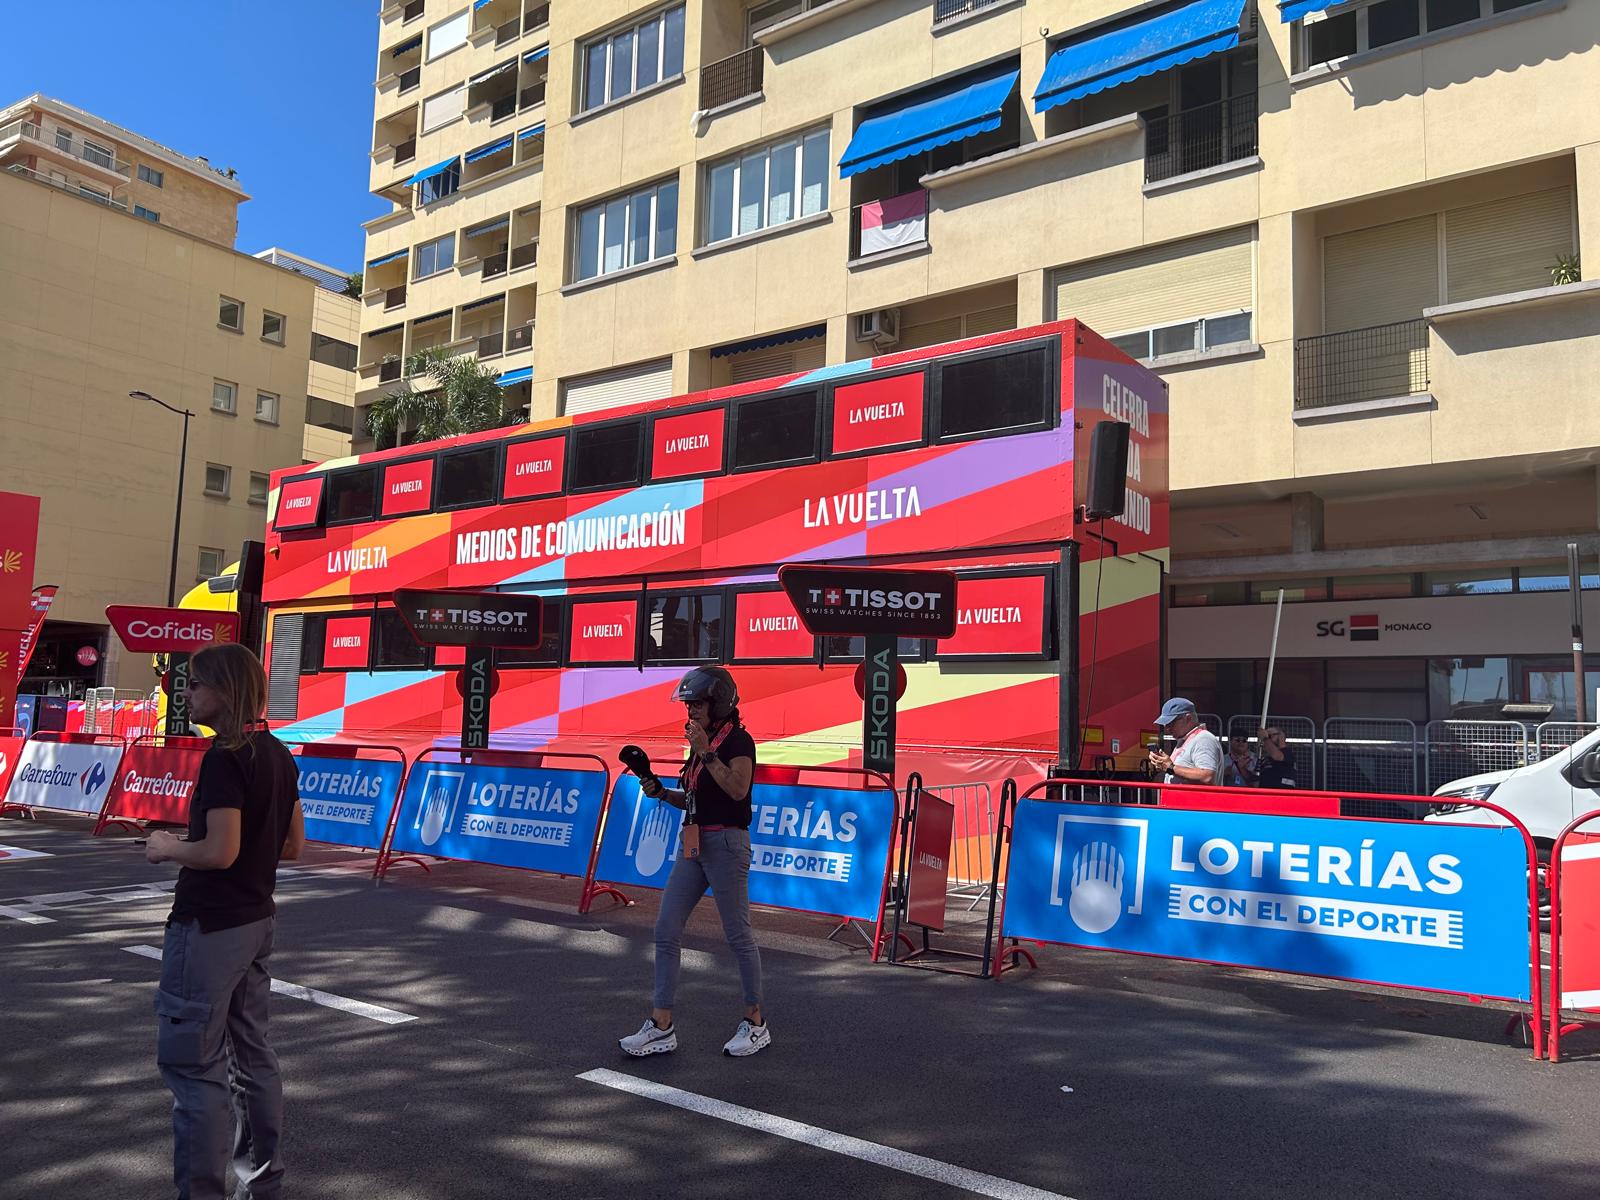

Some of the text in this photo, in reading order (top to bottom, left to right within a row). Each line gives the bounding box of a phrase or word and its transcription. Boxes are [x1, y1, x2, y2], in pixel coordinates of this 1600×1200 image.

[849, 402, 905, 424] LA VUELTA
[1103, 373, 1150, 438] CELEBRA
[666, 434, 709, 453] LA VUELTA
[516, 459, 552, 475] LA VUELTA
[392, 480, 422, 494] LA VUELTA
[286, 496, 312, 509] LA VUELTA
[804, 486, 921, 528] LA VUELTA
[456, 503, 686, 565] MEDIOS DE COMUNICACIÓN
[327, 546, 388, 573] LA VUELTA
[845, 588, 941, 610] TISSOT
[448, 609, 528, 626] TISSOT
[750, 616, 798, 632] LA VUELTA
[840, 609, 883, 617] WATCHES
[887, 611, 915, 619] SINCE
[957, 607, 1021, 624] LA VUELTA
[128, 621, 213, 641] Cofidis
[583, 624, 623, 638] LA VUELTA
[1316, 620, 1432, 637] SG MONACO
[333, 636, 361, 647] LA VUELTA
[20, 763, 77, 786] Carrefour
[123, 770, 193, 797] Carrefour
[297, 770, 382, 798] LOTERÍAS
[468, 781, 580, 814] LOTERÍAS
[301, 802, 367, 819] ON EL DEPORTE
[469, 819, 563, 840] CON EL DEPORTE
[751, 801, 858, 842] ERÍAS
[762, 851, 838, 874] DEPORTE
[1171, 836, 1463, 895] LOTERÍAS
[1188, 895, 1437, 938] CON EL DEPORTE
